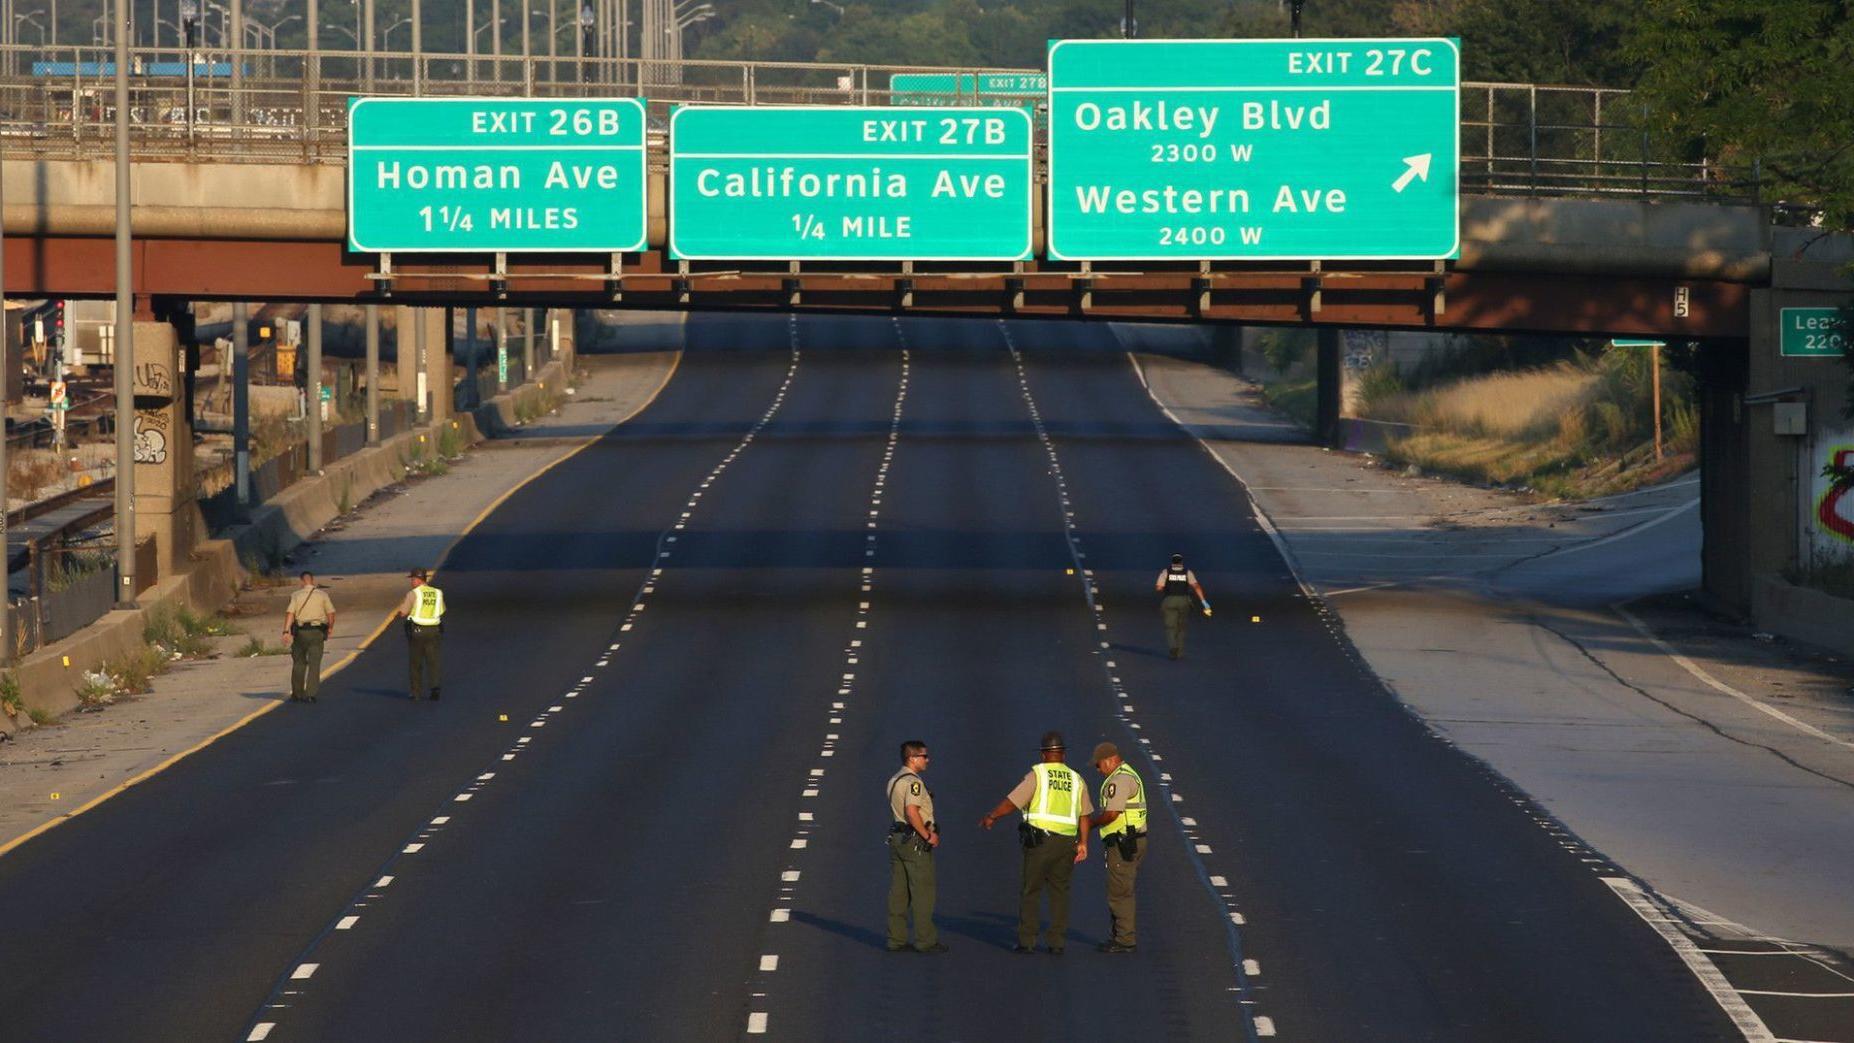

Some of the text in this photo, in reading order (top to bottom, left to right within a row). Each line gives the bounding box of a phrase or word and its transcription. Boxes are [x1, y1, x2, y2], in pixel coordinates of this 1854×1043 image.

[1289, 49, 1432, 76] EXIT 27C
[989, 78, 1014, 88] EXIT
[473, 109, 619, 136] EXIT 26B
[1075, 100, 1330, 138] Oakley Blvd
[864, 119, 1006, 145] EXIT 27B
[1151, 145, 1252, 163] 2300 W
[377, 161, 618, 189] Homan Ave
[697, 167, 1005, 198] California Ave
[1076, 186, 1346, 214] Western Ave
[490, 207, 578, 229] MILES
[842, 216, 911, 238] MILE
[1159, 227, 1262, 245] 2400 W
[1047, 769, 1072, 780] STATE
[1048, 779, 1072, 792] POLICE
